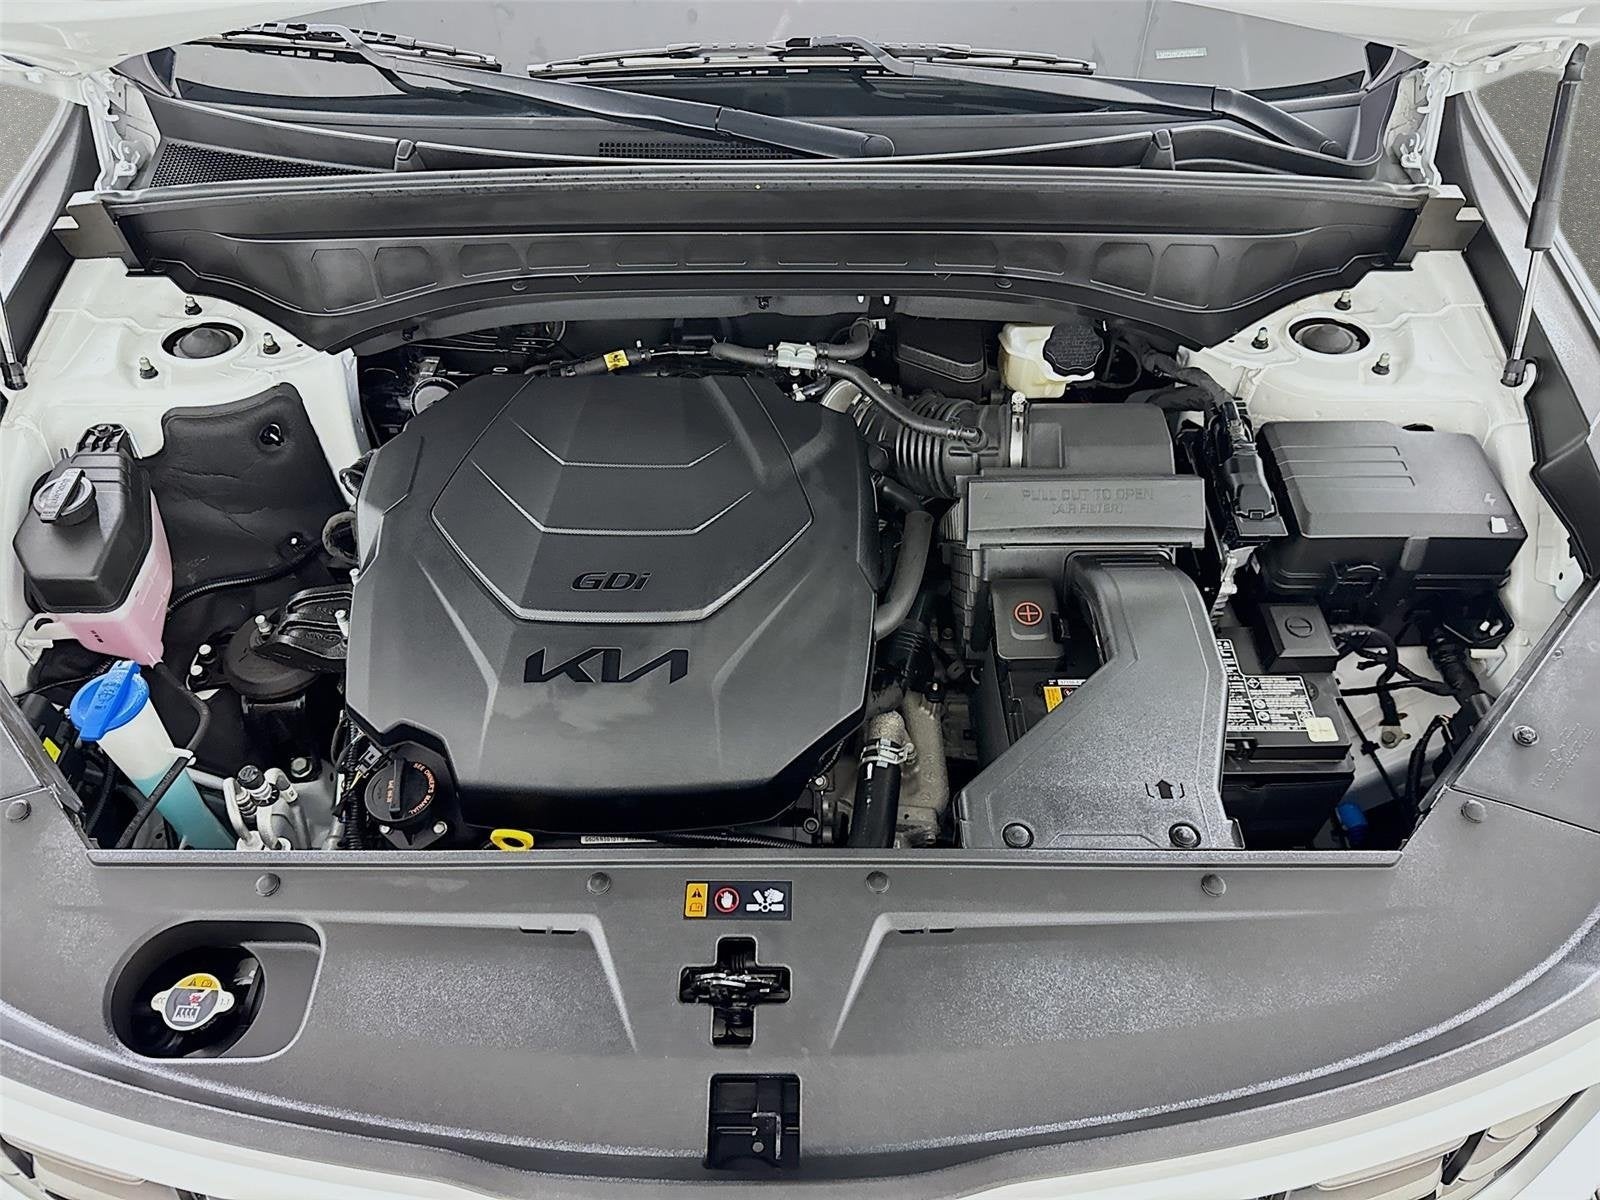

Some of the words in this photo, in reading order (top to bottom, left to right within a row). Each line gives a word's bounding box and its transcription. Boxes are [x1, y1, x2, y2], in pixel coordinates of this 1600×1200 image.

[1061, 487, 1089, 501] OUT
[1092, 487, 1111, 500] TO
[1115, 487, 1154, 500] OPEN
[571, 572, 652, 591] GDi
[523, 647, 689, 684] KIA
[413, 762, 426, 772] SEE
[408, 794, 432, 815] MANUAL
